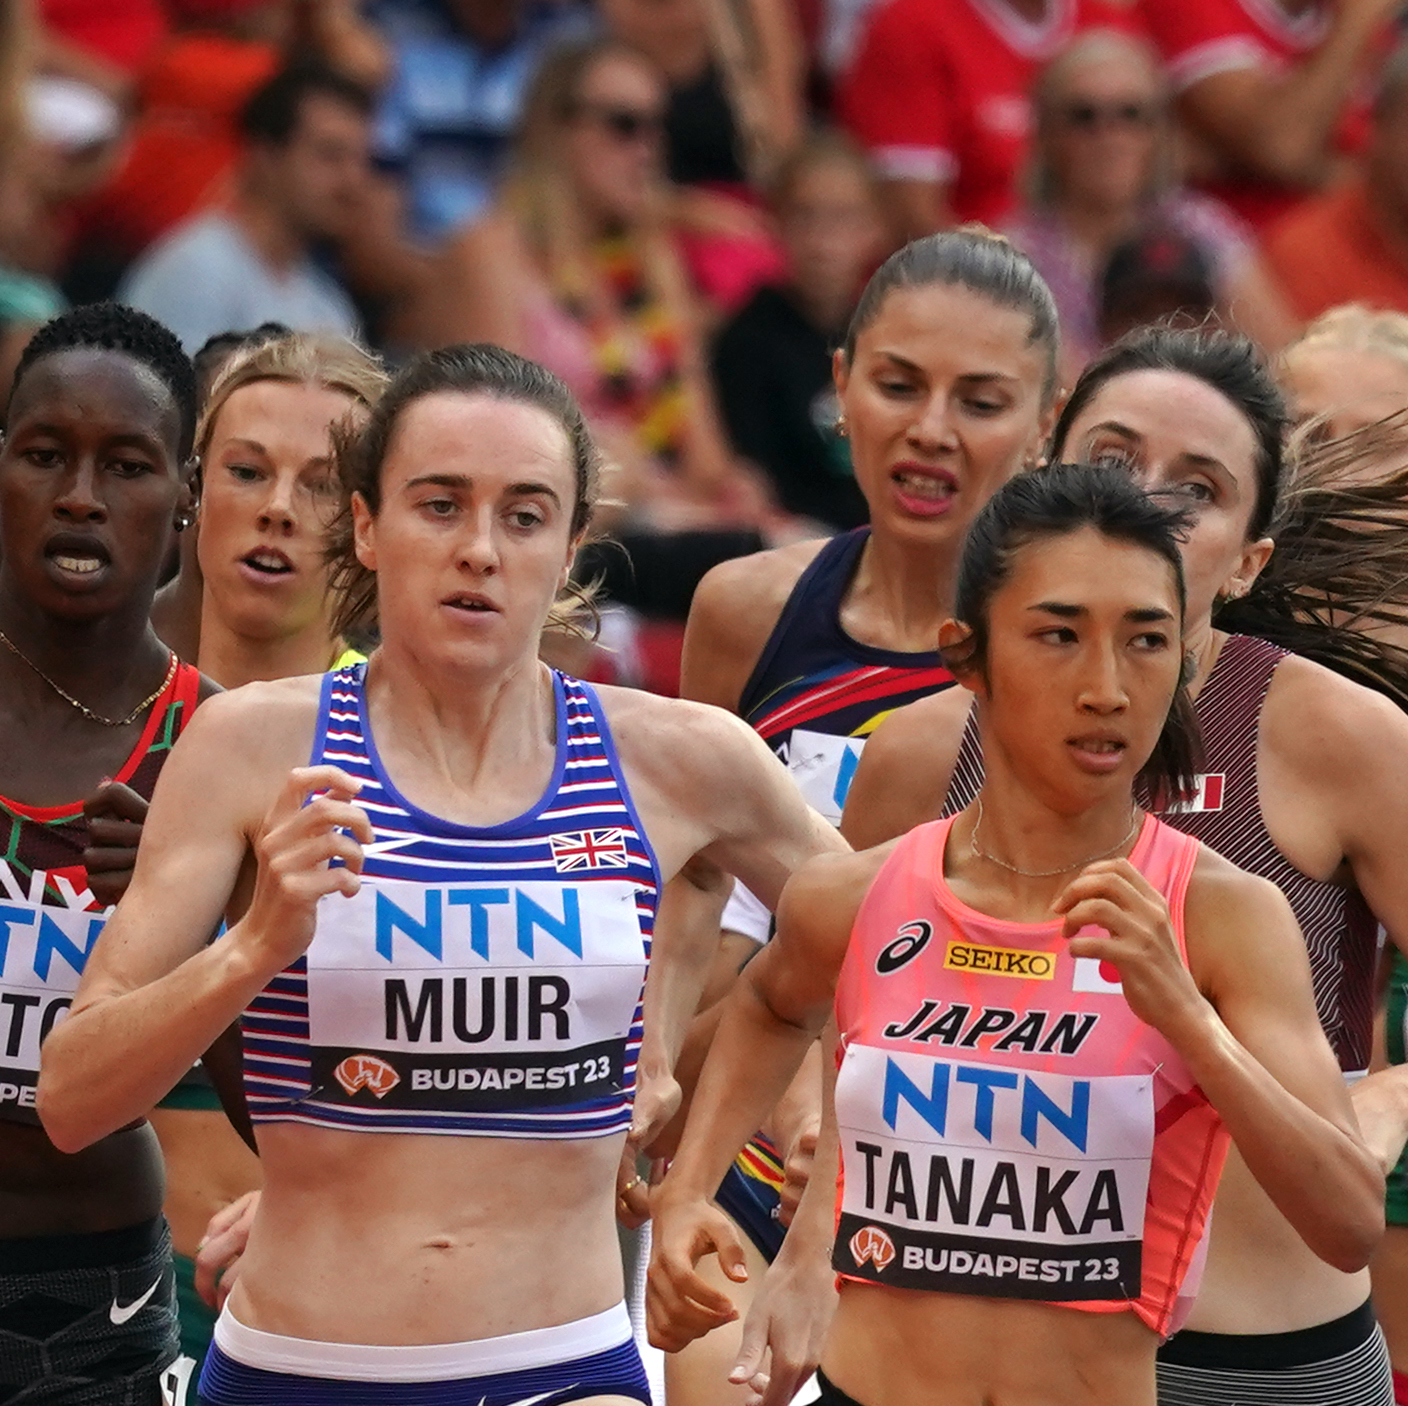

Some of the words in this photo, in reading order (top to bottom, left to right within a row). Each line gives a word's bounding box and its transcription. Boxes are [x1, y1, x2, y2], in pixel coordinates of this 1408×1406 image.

[375, 887, 583, 964] NTN
[948, 944, 1051, 977] SEIKO
[384, 975, 572, 1044] MUIR
[882, 998, 1100, 1057] JAPAN
[411, 1063, 580, 1091] BUDAPEST
[582, 1055, 611, 1084] 23
[882, 1054, 1091, 1155] NTN
[855, 1140, 1125, 1236] TANAKA
[902, 1245, 1080, 1283] BUDAPEST
[1083, 1257, 1121, 1282] 23
